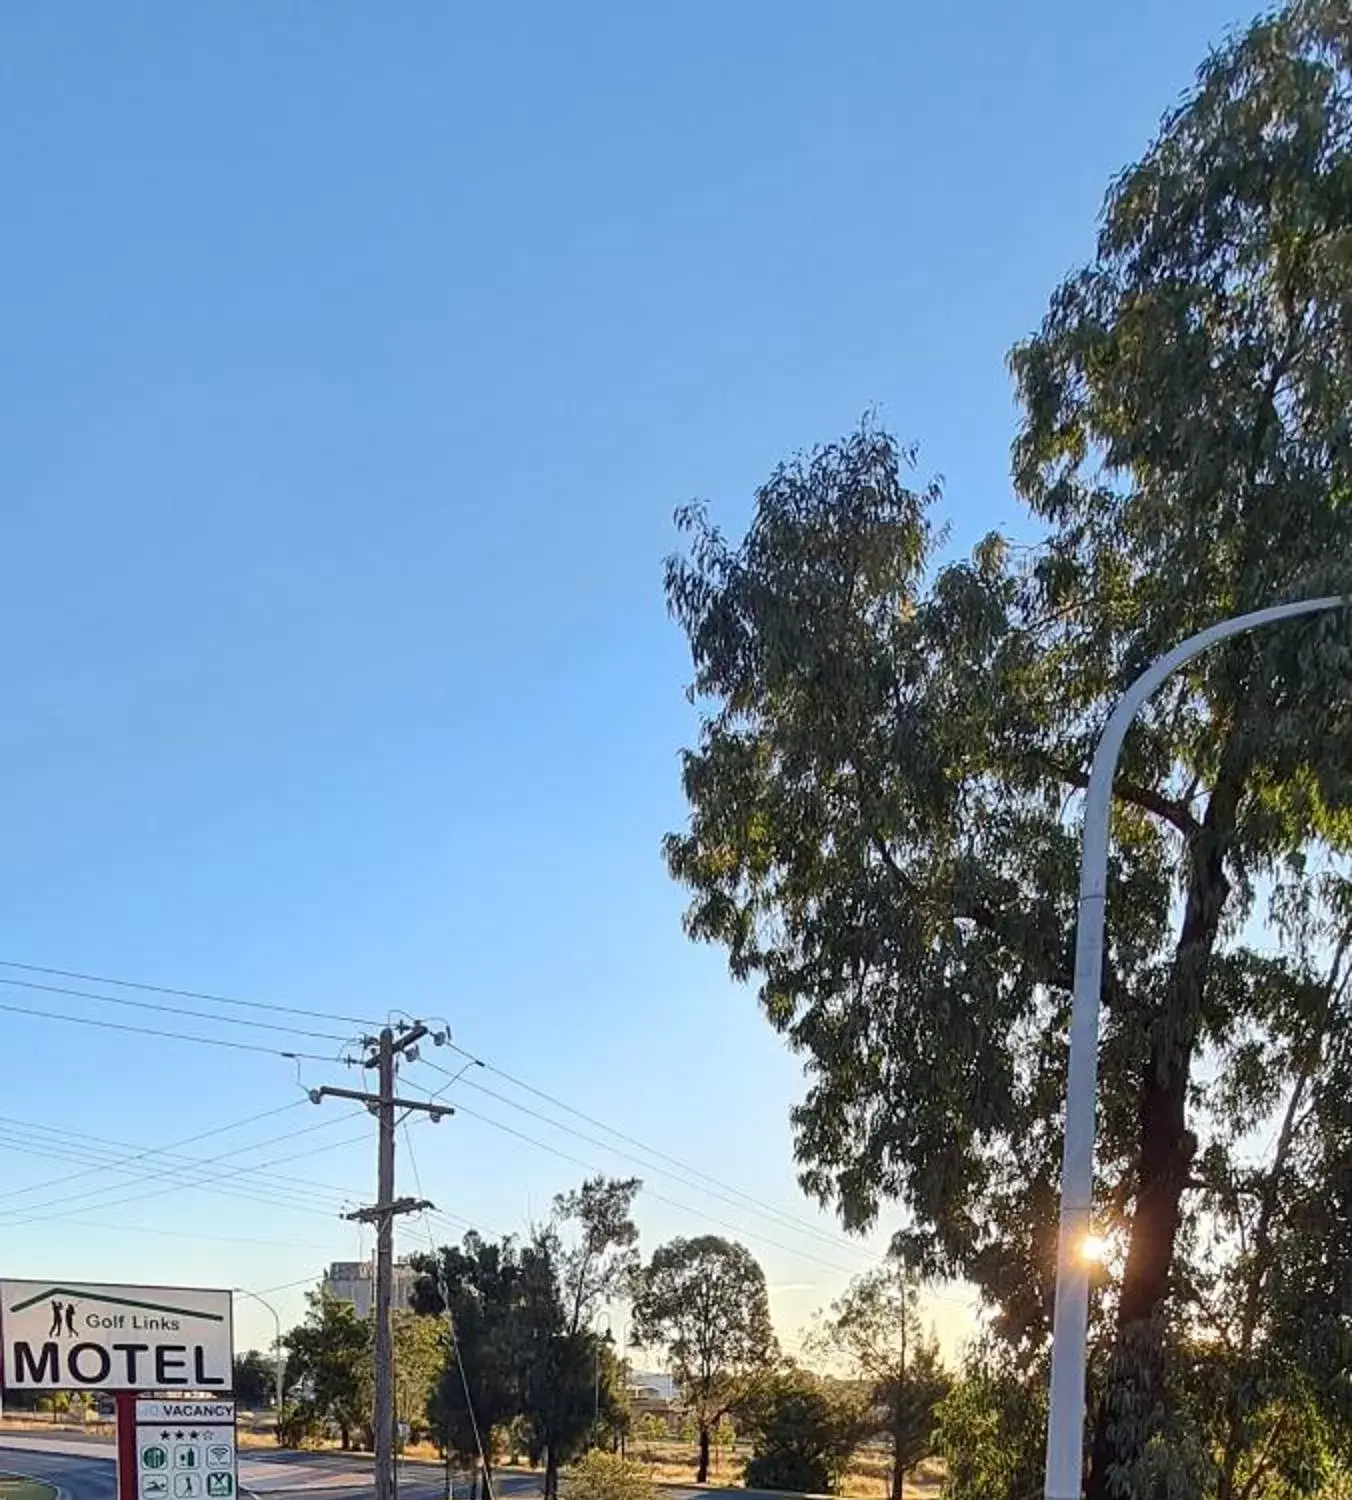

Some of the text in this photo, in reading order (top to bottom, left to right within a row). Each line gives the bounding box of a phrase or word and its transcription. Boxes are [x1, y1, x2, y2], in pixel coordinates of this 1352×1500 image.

[86, 1314, 180, 1331] Golf Links
[13, 1341, 225, 1384] MOTEL
[163, 1405, 233, 1417] VACANCY
